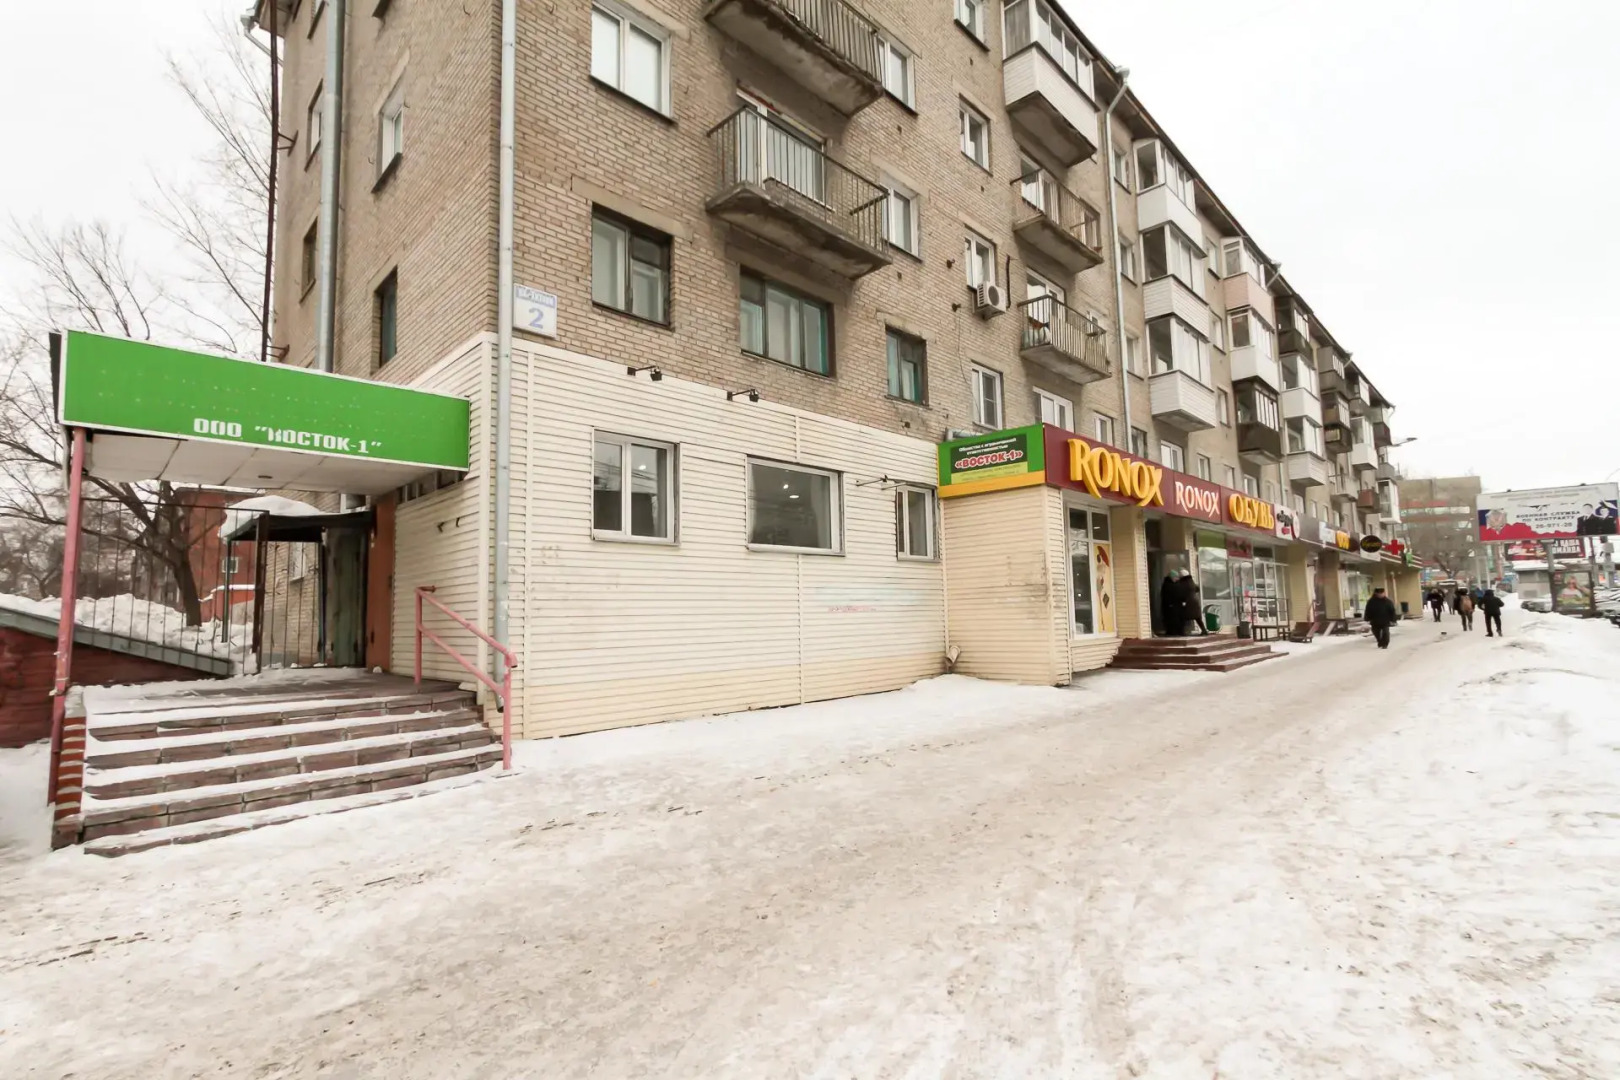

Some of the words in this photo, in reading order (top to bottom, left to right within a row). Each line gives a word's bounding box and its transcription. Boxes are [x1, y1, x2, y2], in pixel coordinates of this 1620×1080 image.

[528, 308, 544, 329] 2
[193, 418, 242, 438] ООО
[955, 450, 1024, 469] «ВОСТОК-1»
[1067, 438, 1164, 507] RONOX
[1175, 481, 1220, 518] RONOX
[1229, 493, 1275, 530] ОБУВЬ
